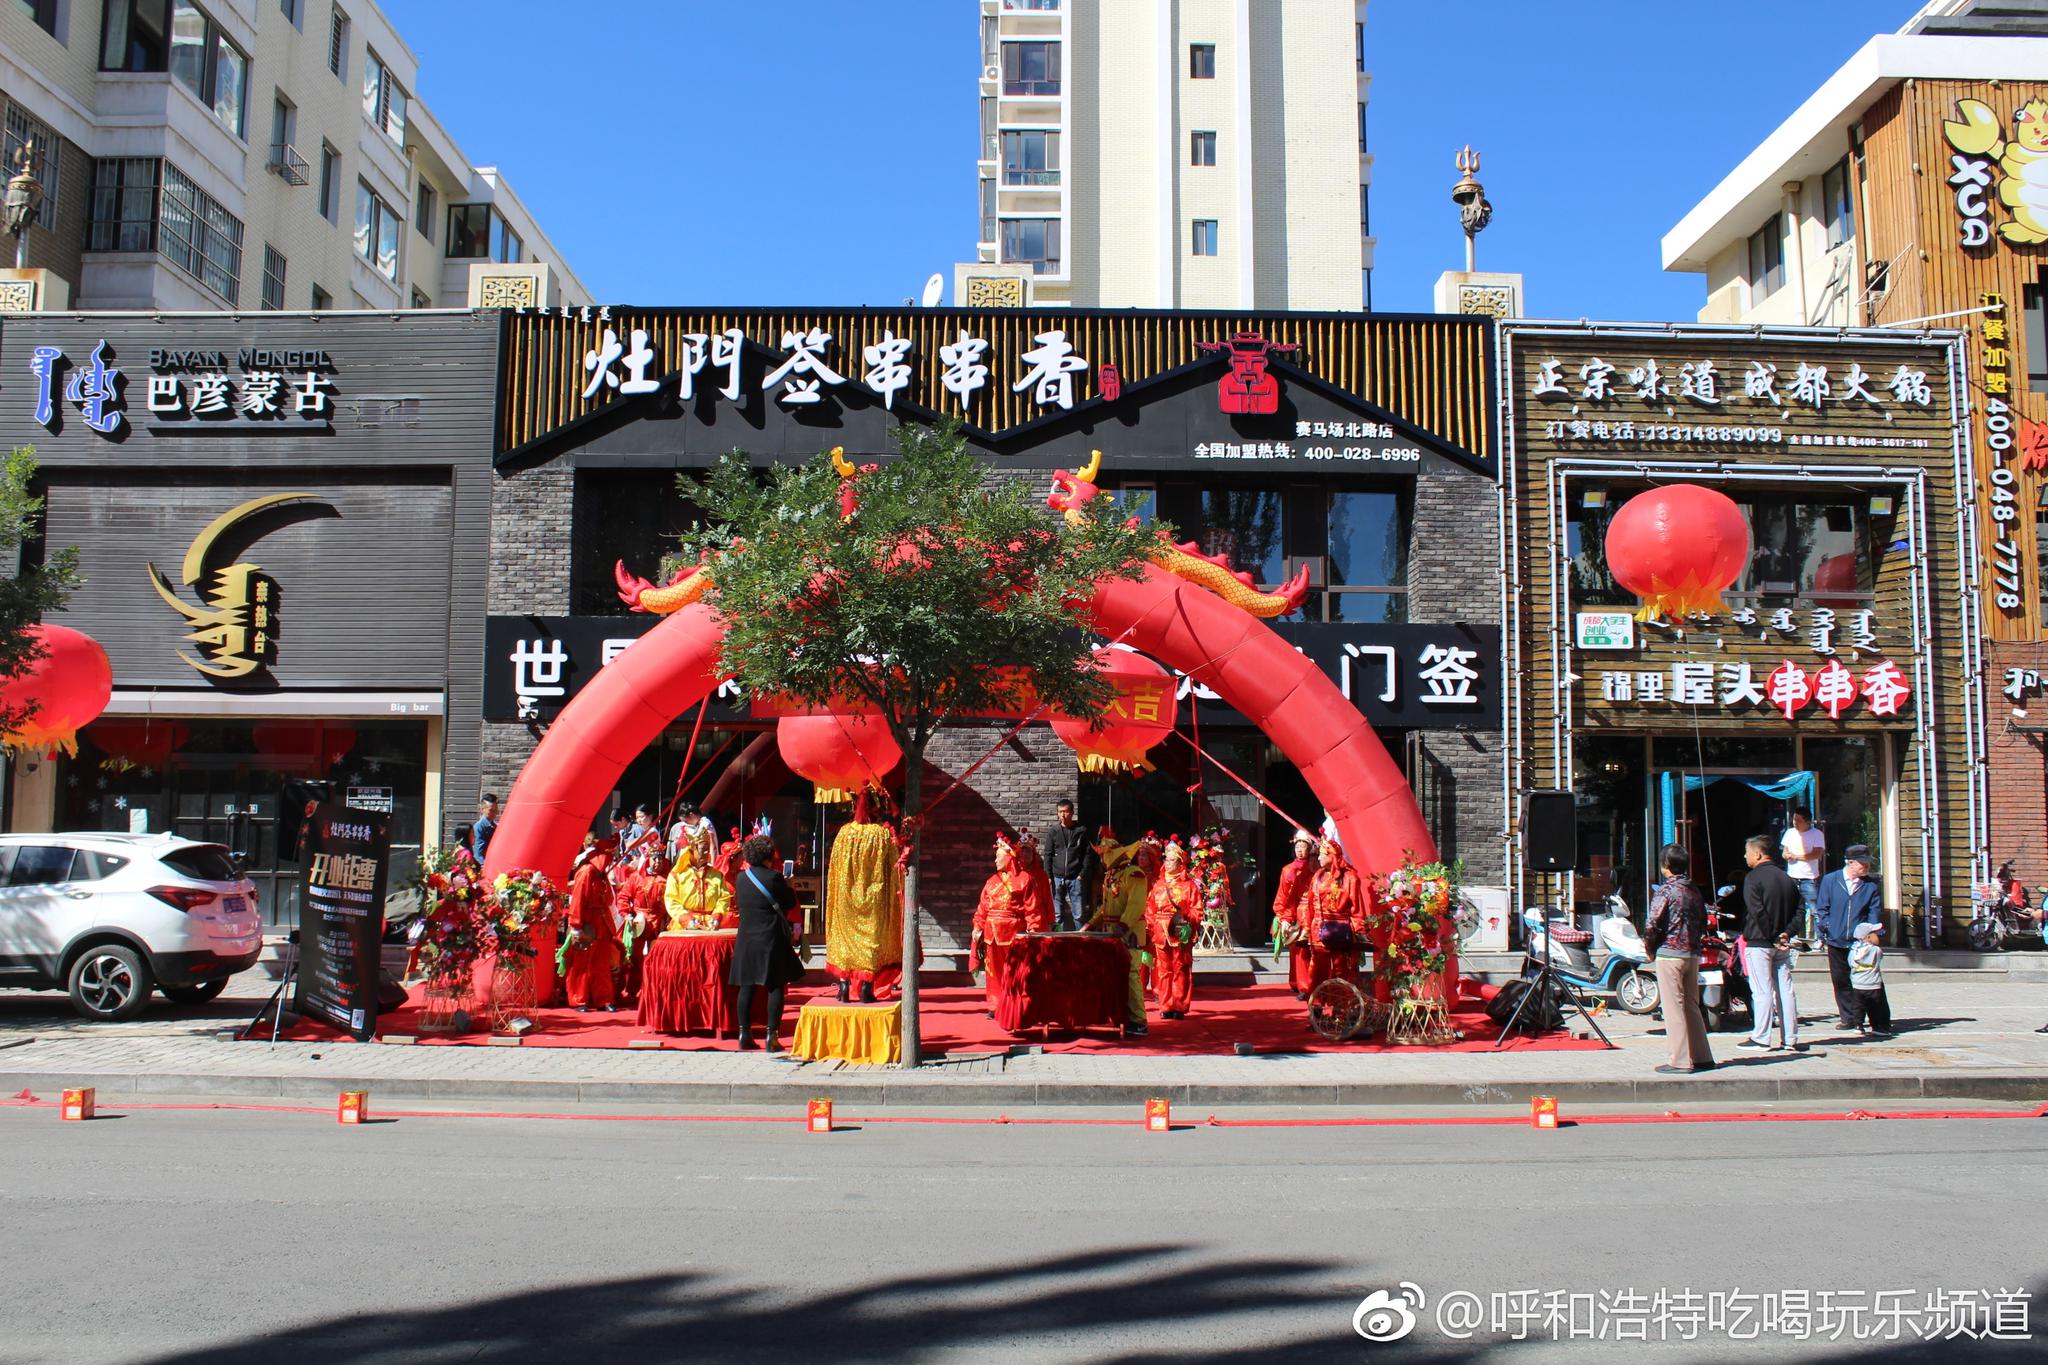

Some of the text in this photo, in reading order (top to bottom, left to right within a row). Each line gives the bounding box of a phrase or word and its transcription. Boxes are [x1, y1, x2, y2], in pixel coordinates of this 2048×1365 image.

[150, 347, 331, 367] BAYAN MONGOL
[147, 371, 332, 414] 巴彦蒙古
[1294, 421, 1394, 440] 赛马场北路店
[390, 703, 429, 713] Big bar
